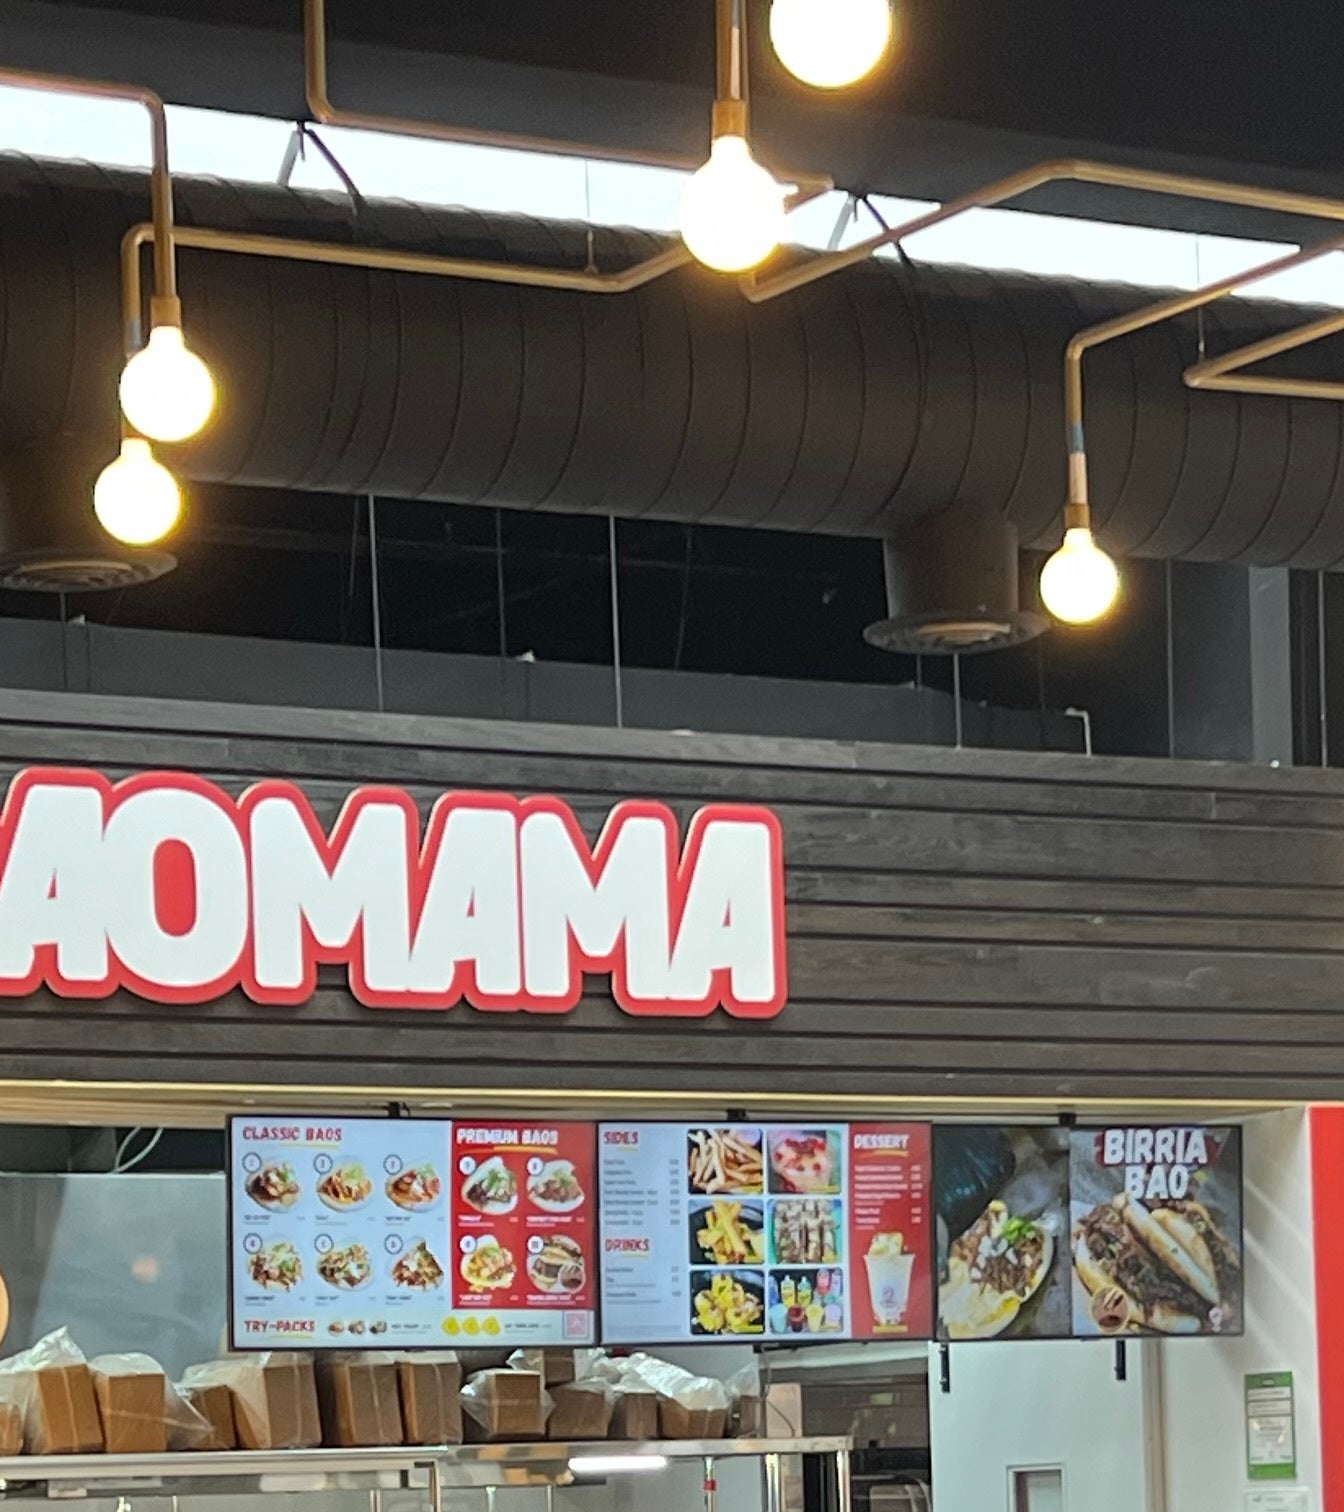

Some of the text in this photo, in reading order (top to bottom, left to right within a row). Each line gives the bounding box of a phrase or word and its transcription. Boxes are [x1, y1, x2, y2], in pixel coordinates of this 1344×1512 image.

[242, 1126, 342, 1142] CLASSIC BAOS
[456, 1128, 559, 1145] PREMIUM BAOS
[603, 1130, 639, 1145] SIDES
[854, 1133, 910, 1150] DESSERT
[1103, 1128, 1208, 1164] BIRRIA
[1125, 1164, 1190, 1200] BAO
[605, 1238, 650, 1253] DRINKS
[244, 1320, 316, 1334] TRY-PACKS
